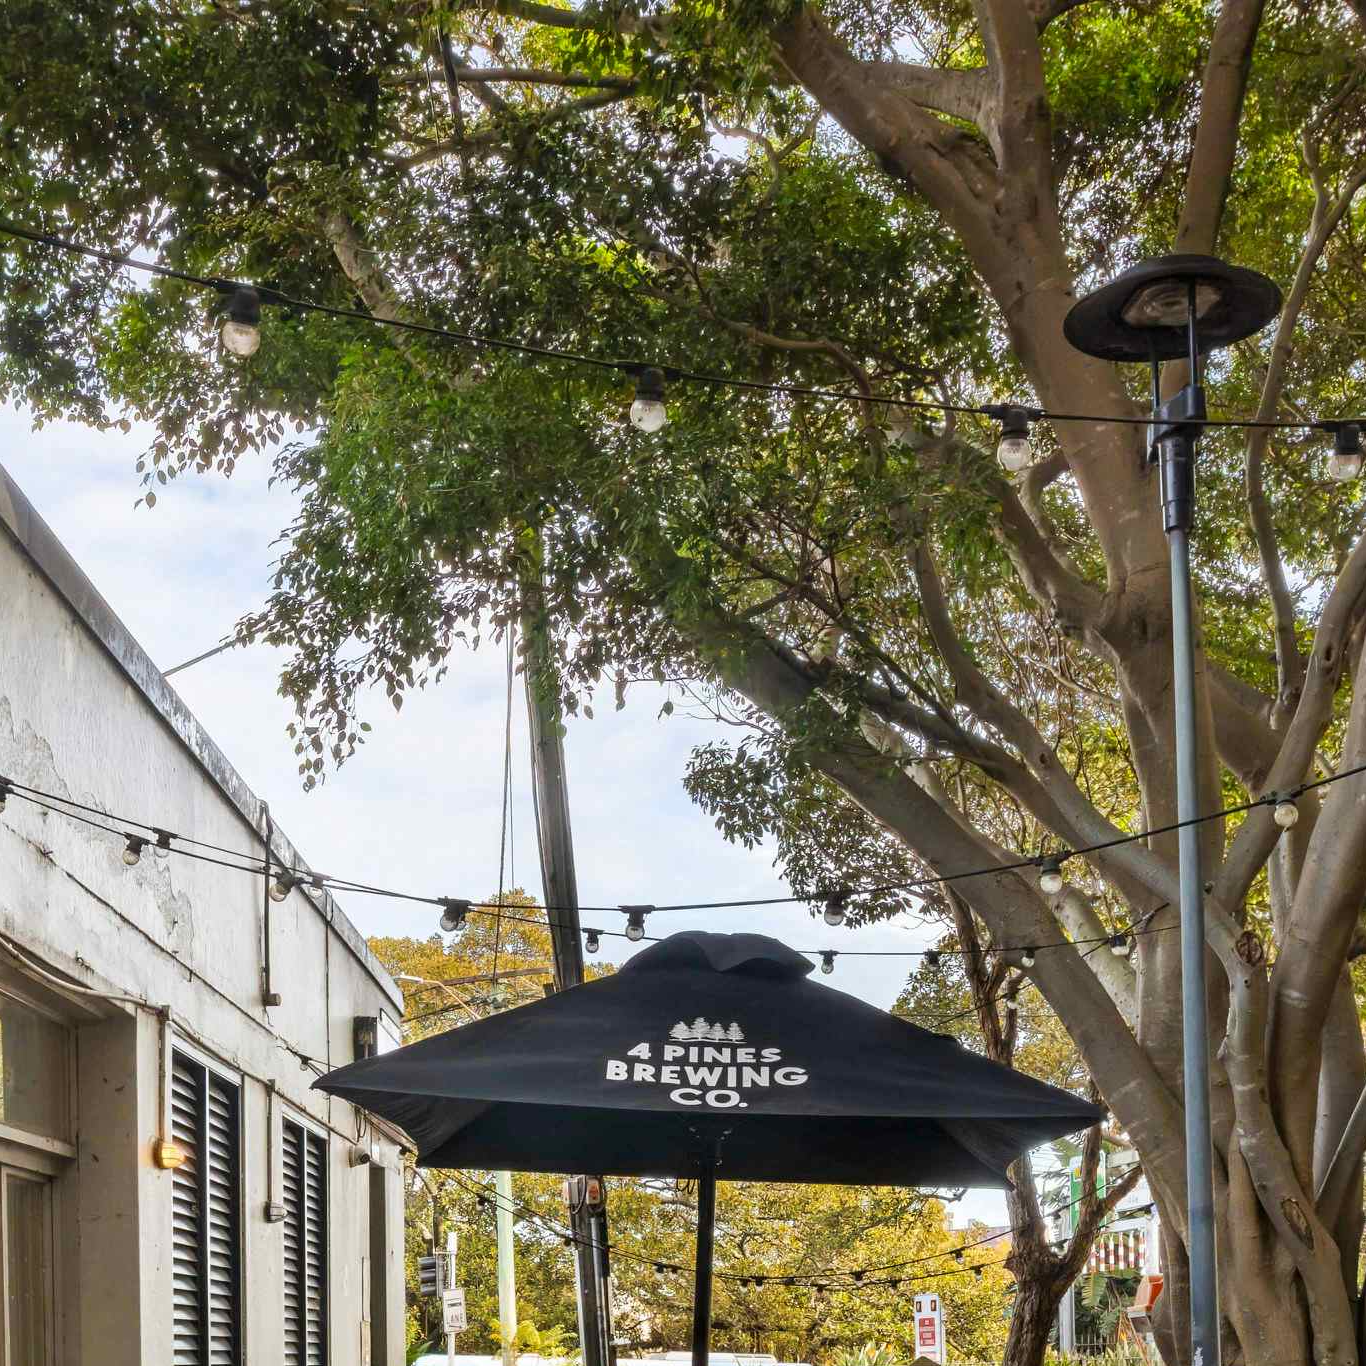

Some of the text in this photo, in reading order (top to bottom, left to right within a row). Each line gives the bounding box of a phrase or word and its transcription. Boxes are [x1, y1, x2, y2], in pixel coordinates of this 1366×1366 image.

[627, 1042, 782, 1064] 4 PINES
[605, 1059, 809, 1088] BREWING
[669, 1087, 748, 1108] CO.
